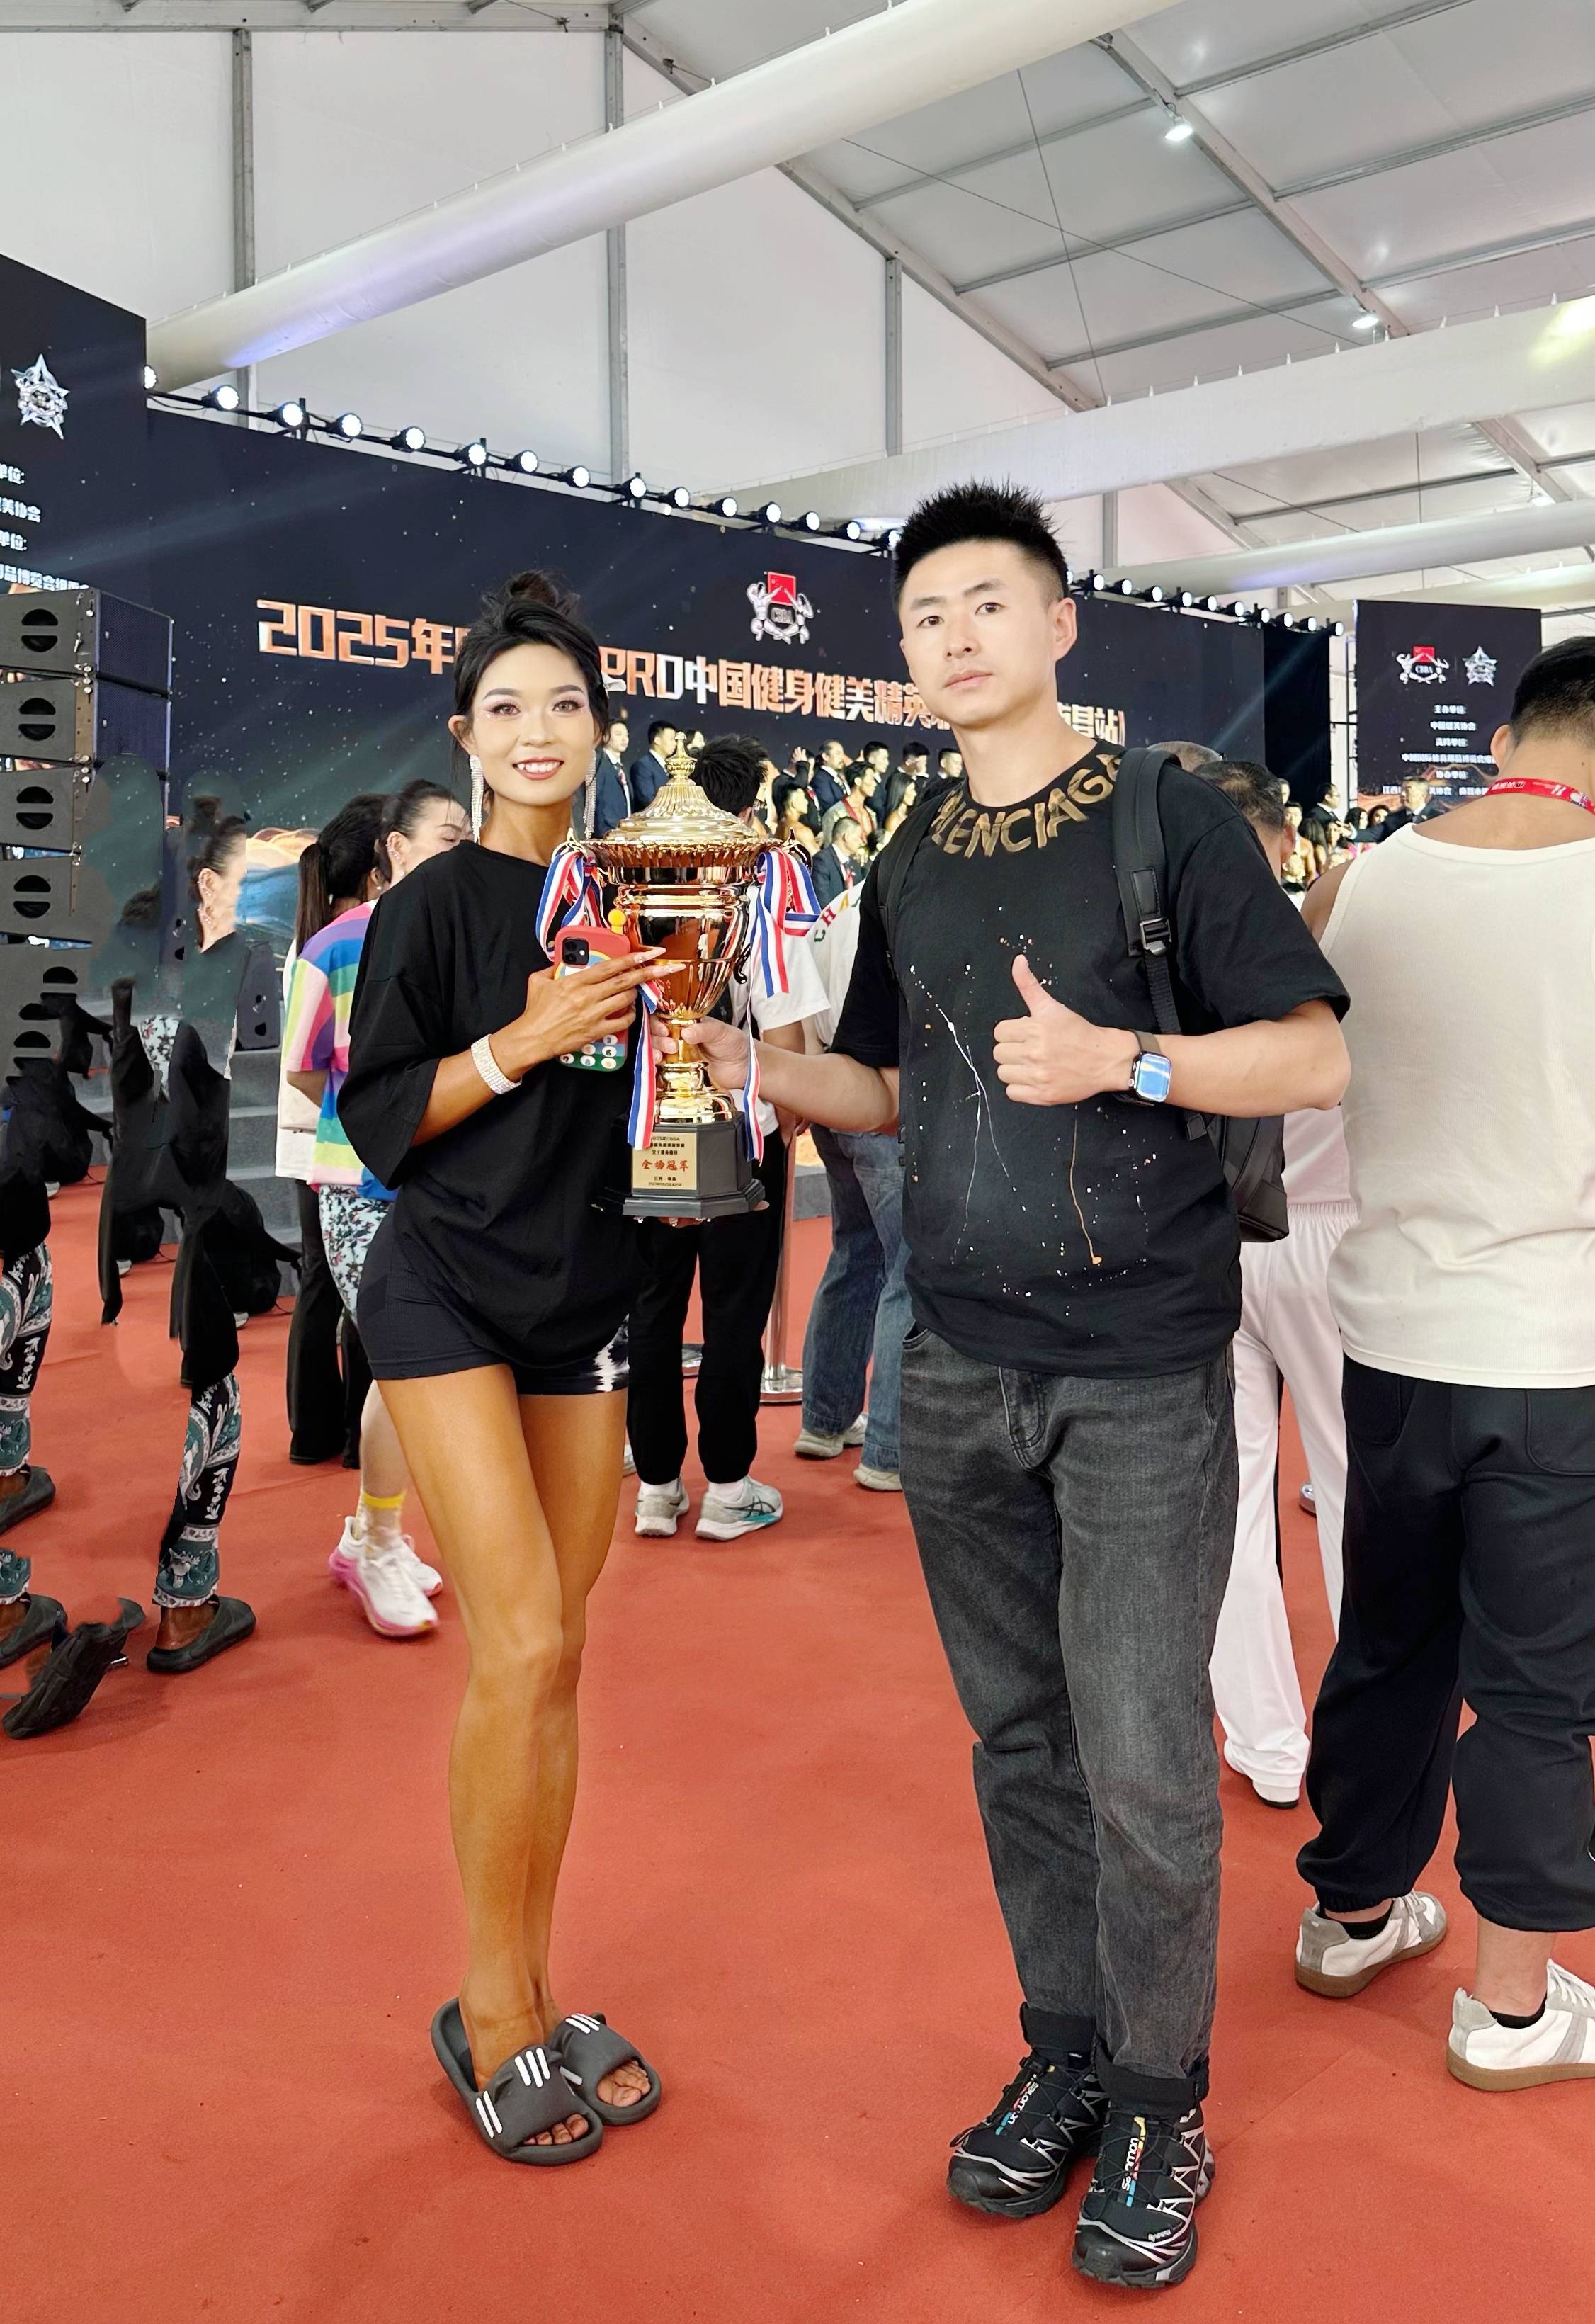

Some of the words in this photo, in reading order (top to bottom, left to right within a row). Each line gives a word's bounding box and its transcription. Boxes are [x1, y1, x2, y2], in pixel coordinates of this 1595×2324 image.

[0, 497, 41, 523] 美协会
[256, 599, 470, 674] 2025年
[641, 1159, 688, 1172] 全场冠军
